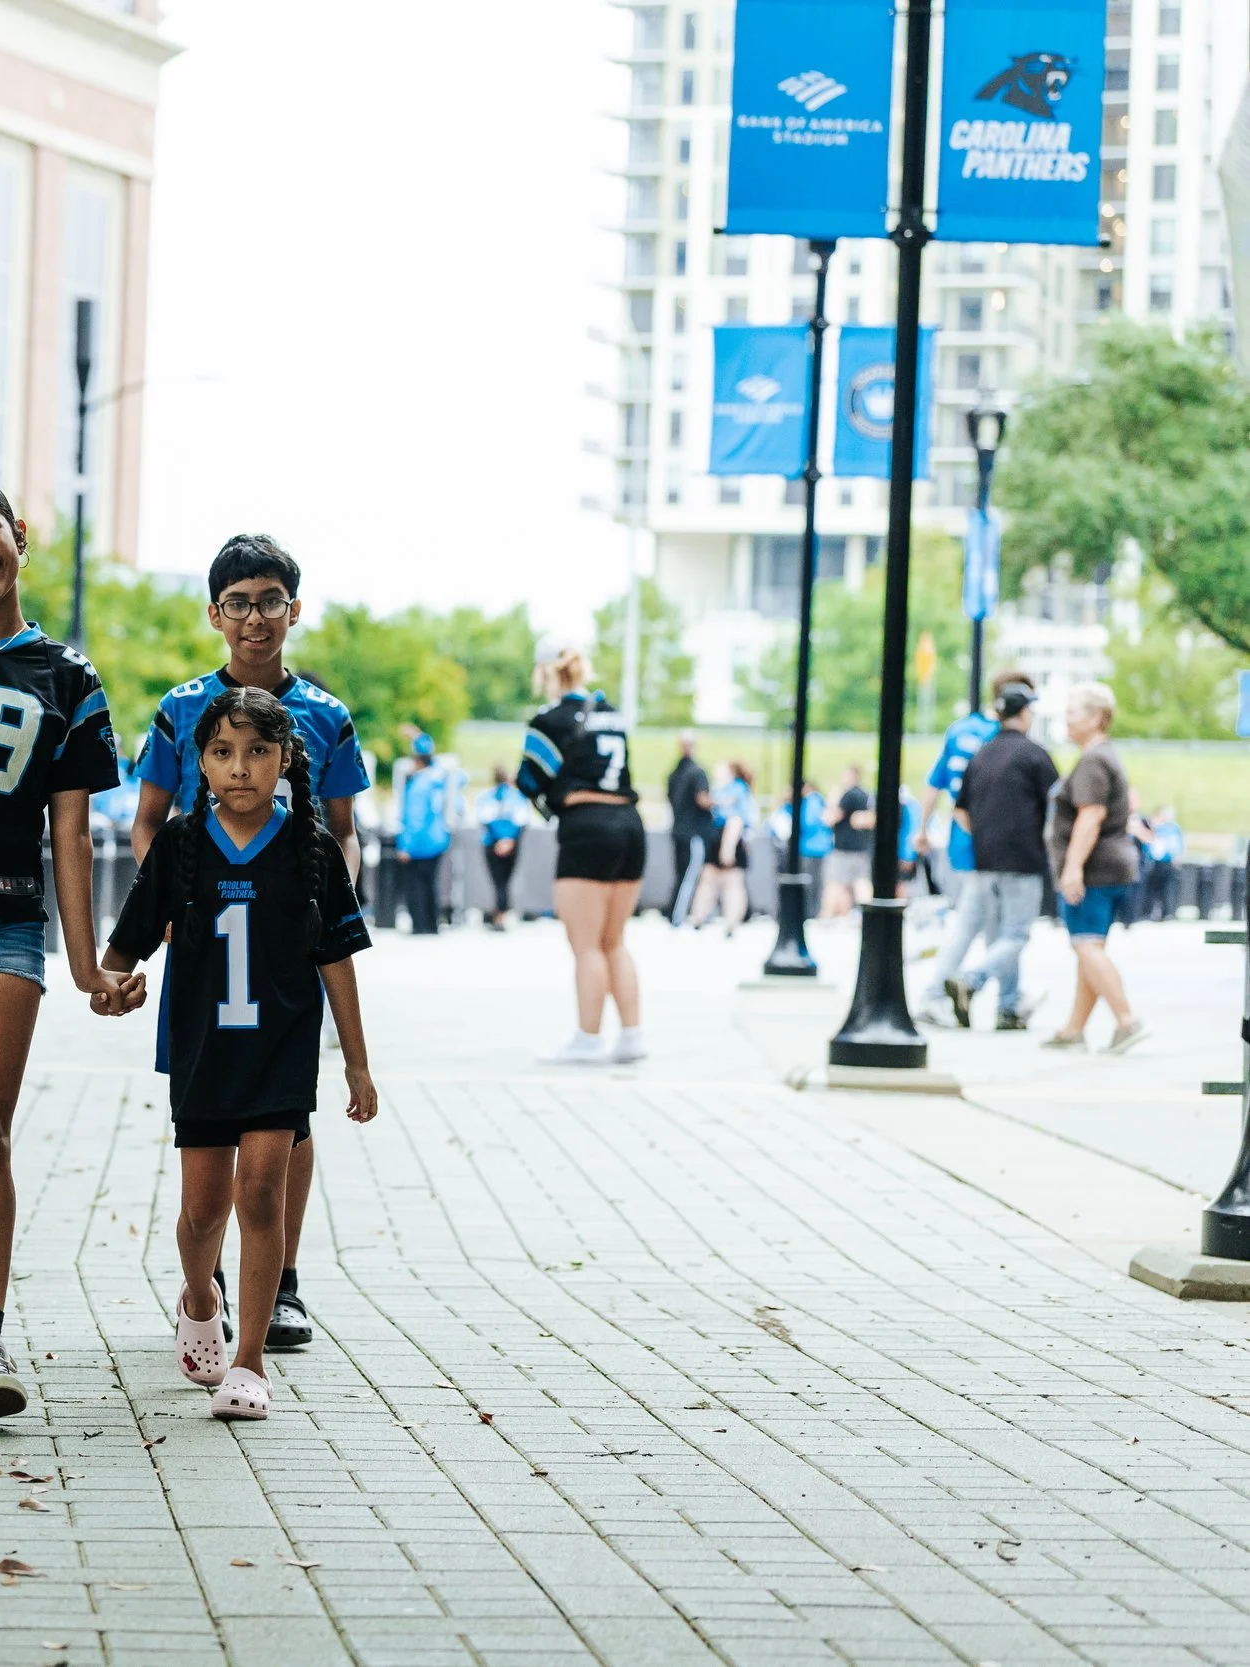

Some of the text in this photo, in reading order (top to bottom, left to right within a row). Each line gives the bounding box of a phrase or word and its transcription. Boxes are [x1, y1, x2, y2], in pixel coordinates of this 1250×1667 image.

[737, 114, 883, 133] BANK OF AMERICA
[949, 119, 1071, 150] CAROLINA
[772, 130, 849, 146] STADIUM
[961, 151, 1090, 182] PANTHERS
[596, 734, 626, 791] 7
[217, 880, 253, 890] CAROLINA
[220, 890, 258, 899] PANTHERS
[215, 901, 260, 1029] 1
